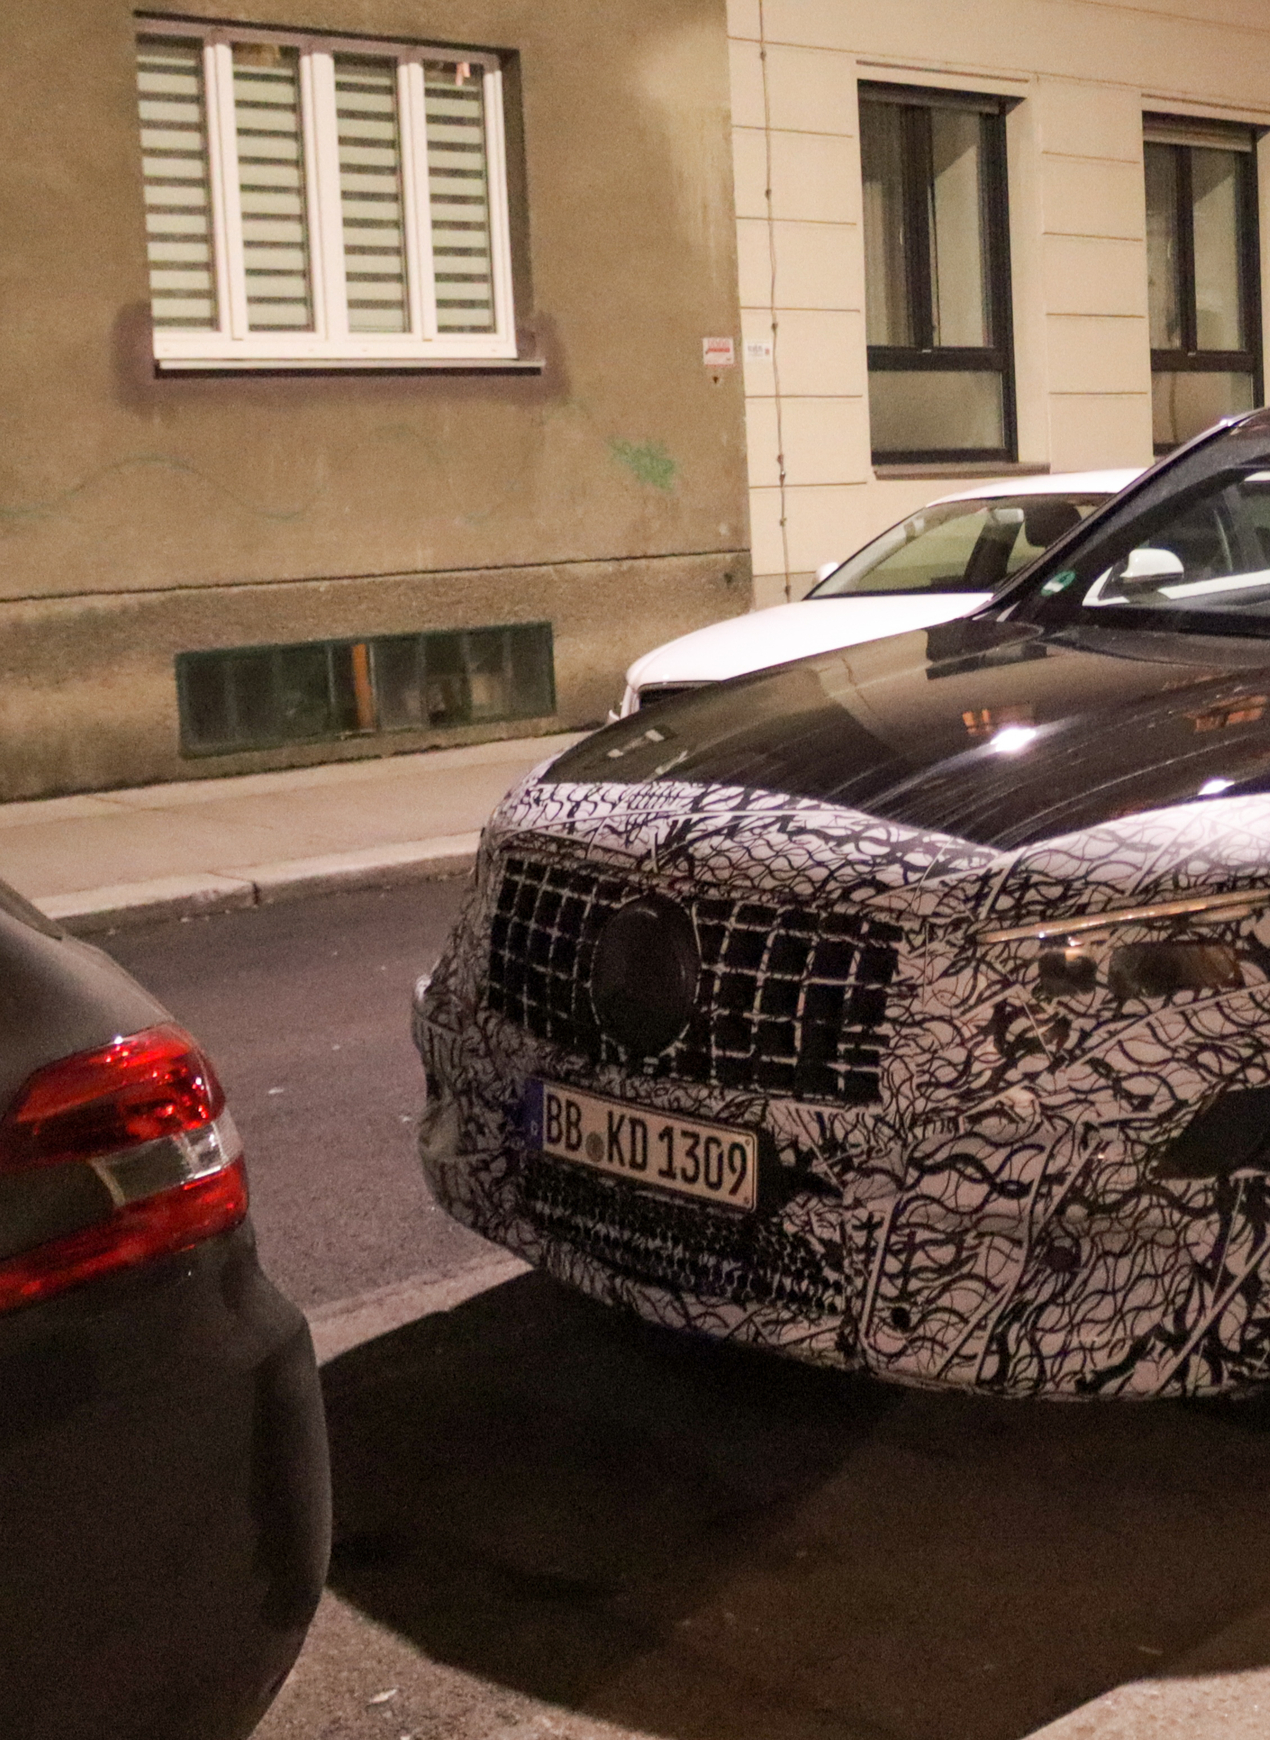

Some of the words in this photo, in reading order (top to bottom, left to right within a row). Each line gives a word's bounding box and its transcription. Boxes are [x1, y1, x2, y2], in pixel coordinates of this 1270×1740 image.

[546, 1093, 583, 1152] BB
[606, 1109, 649, 1172] KD
[657, 1124, 748, 1197] 1309
